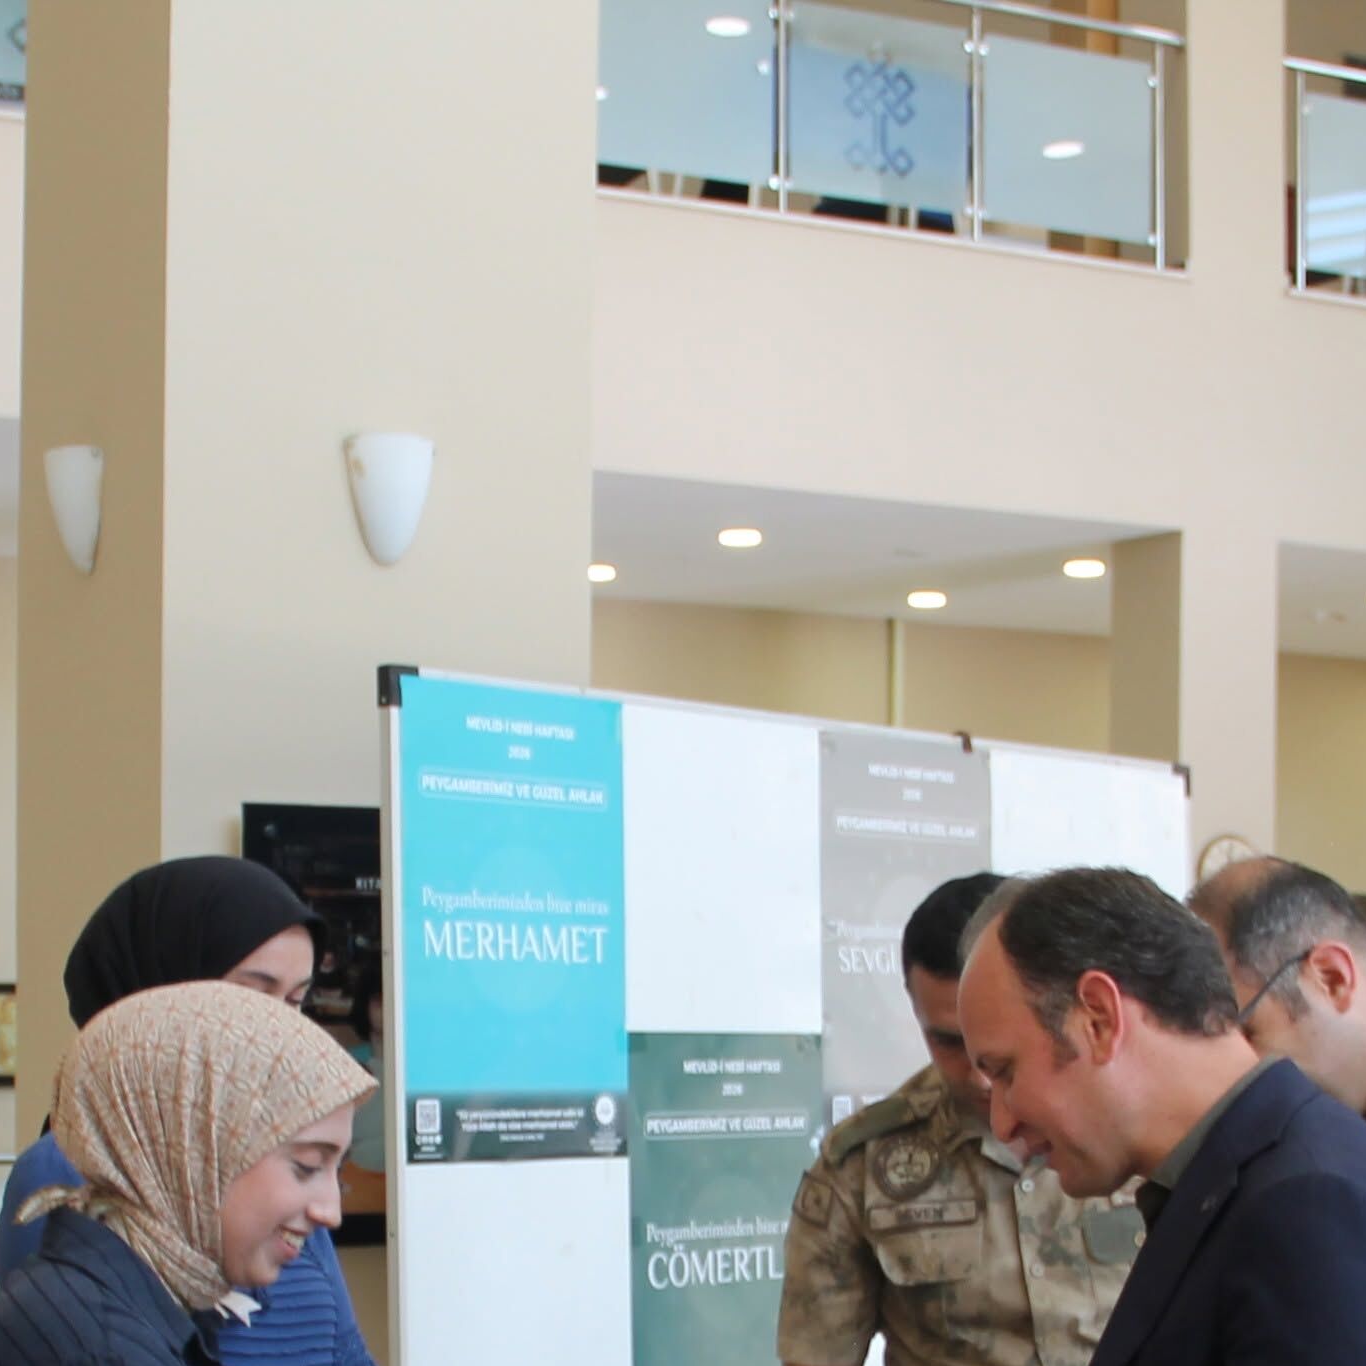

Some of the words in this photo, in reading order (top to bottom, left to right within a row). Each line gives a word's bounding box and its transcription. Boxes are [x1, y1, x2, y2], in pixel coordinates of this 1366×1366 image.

[516, 784, 531, 800] VE
[424, 919, 608, 965] MERHAMET
[729, 1118, 742, 1132] VE
[646, 1219, 754, 1248] Peygamberimizden
[647, 1244, 785, 1290] CÖMERTL
